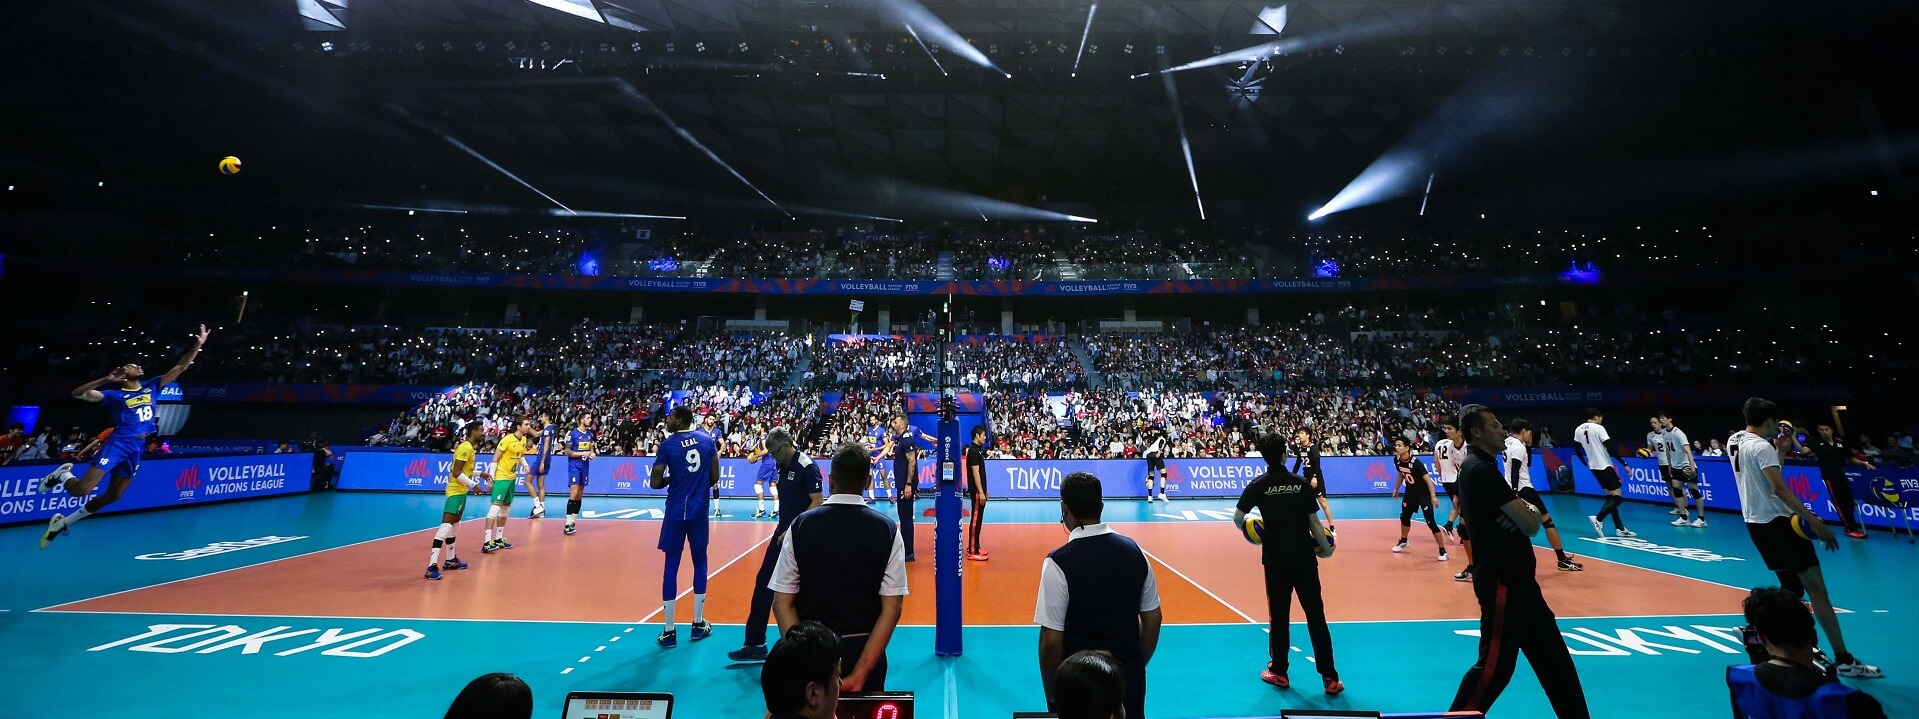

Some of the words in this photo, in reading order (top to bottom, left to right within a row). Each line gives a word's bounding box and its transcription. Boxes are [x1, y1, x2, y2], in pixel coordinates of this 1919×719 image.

[629, 280, 675, 288] VOLLEYBALL
[840, 283, 887, 291] VOLLEYBALL
[1060, 284, 1106, 292] VOLLEYBALL
[1505, 393, 1563, 401] VOLLEYBALL
[136, 406, 153, 423] 18
[1583, 430, 1590, 444] 1
[681, 439, 699, 448] LEAL
[1657, 443, 1664, 452] 2
[1437, 446, 1449, 460] 12
[1730, 444, 1740, 473] 7
[100, 458, 110, 466] 18
[685, 449, 701, 473] 9
[1300, 457, 1311, 468] 22
[209, 463, 286, 481] VOLLEYBALL
[1006, 467, 1063, 490] TOKYO
[206, 481, 247, 496] NATIONS
[251, 478, 285, 492] LEAGUE
[1190, 480, 1238, 490] NATIONS
[1264, 484, 1302, 494] JAPAN
[1628, 483, 1670, 497] NATIONS
[180, 491, 195, 499] FIVB
[87, 624, 427, 658] TOKYO
